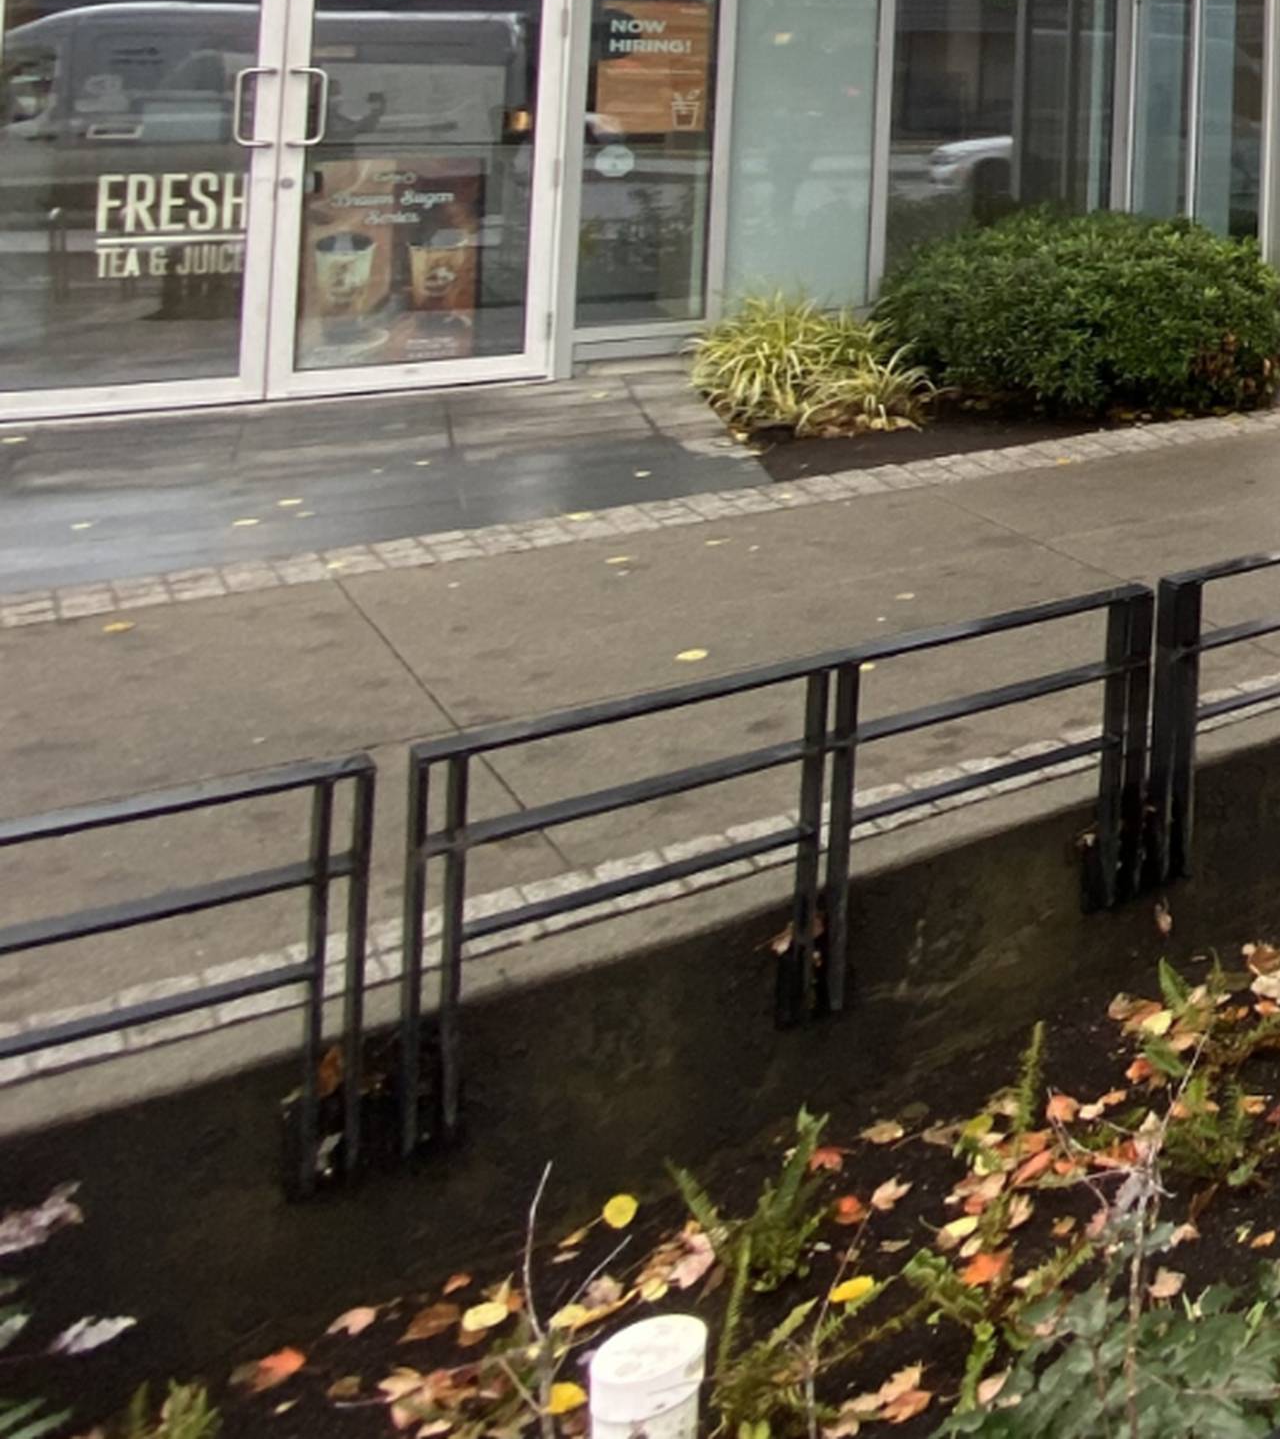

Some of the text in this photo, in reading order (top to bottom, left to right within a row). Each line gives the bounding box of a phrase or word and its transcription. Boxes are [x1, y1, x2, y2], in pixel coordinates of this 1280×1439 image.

[610, 19, 667, 34] NOW
[608, 38, 692, 54] HIRING!
[96, 171, 249, 233] FRESH
[96, 247, 141, 278] TEA
[149, 245, 169, 276] &
